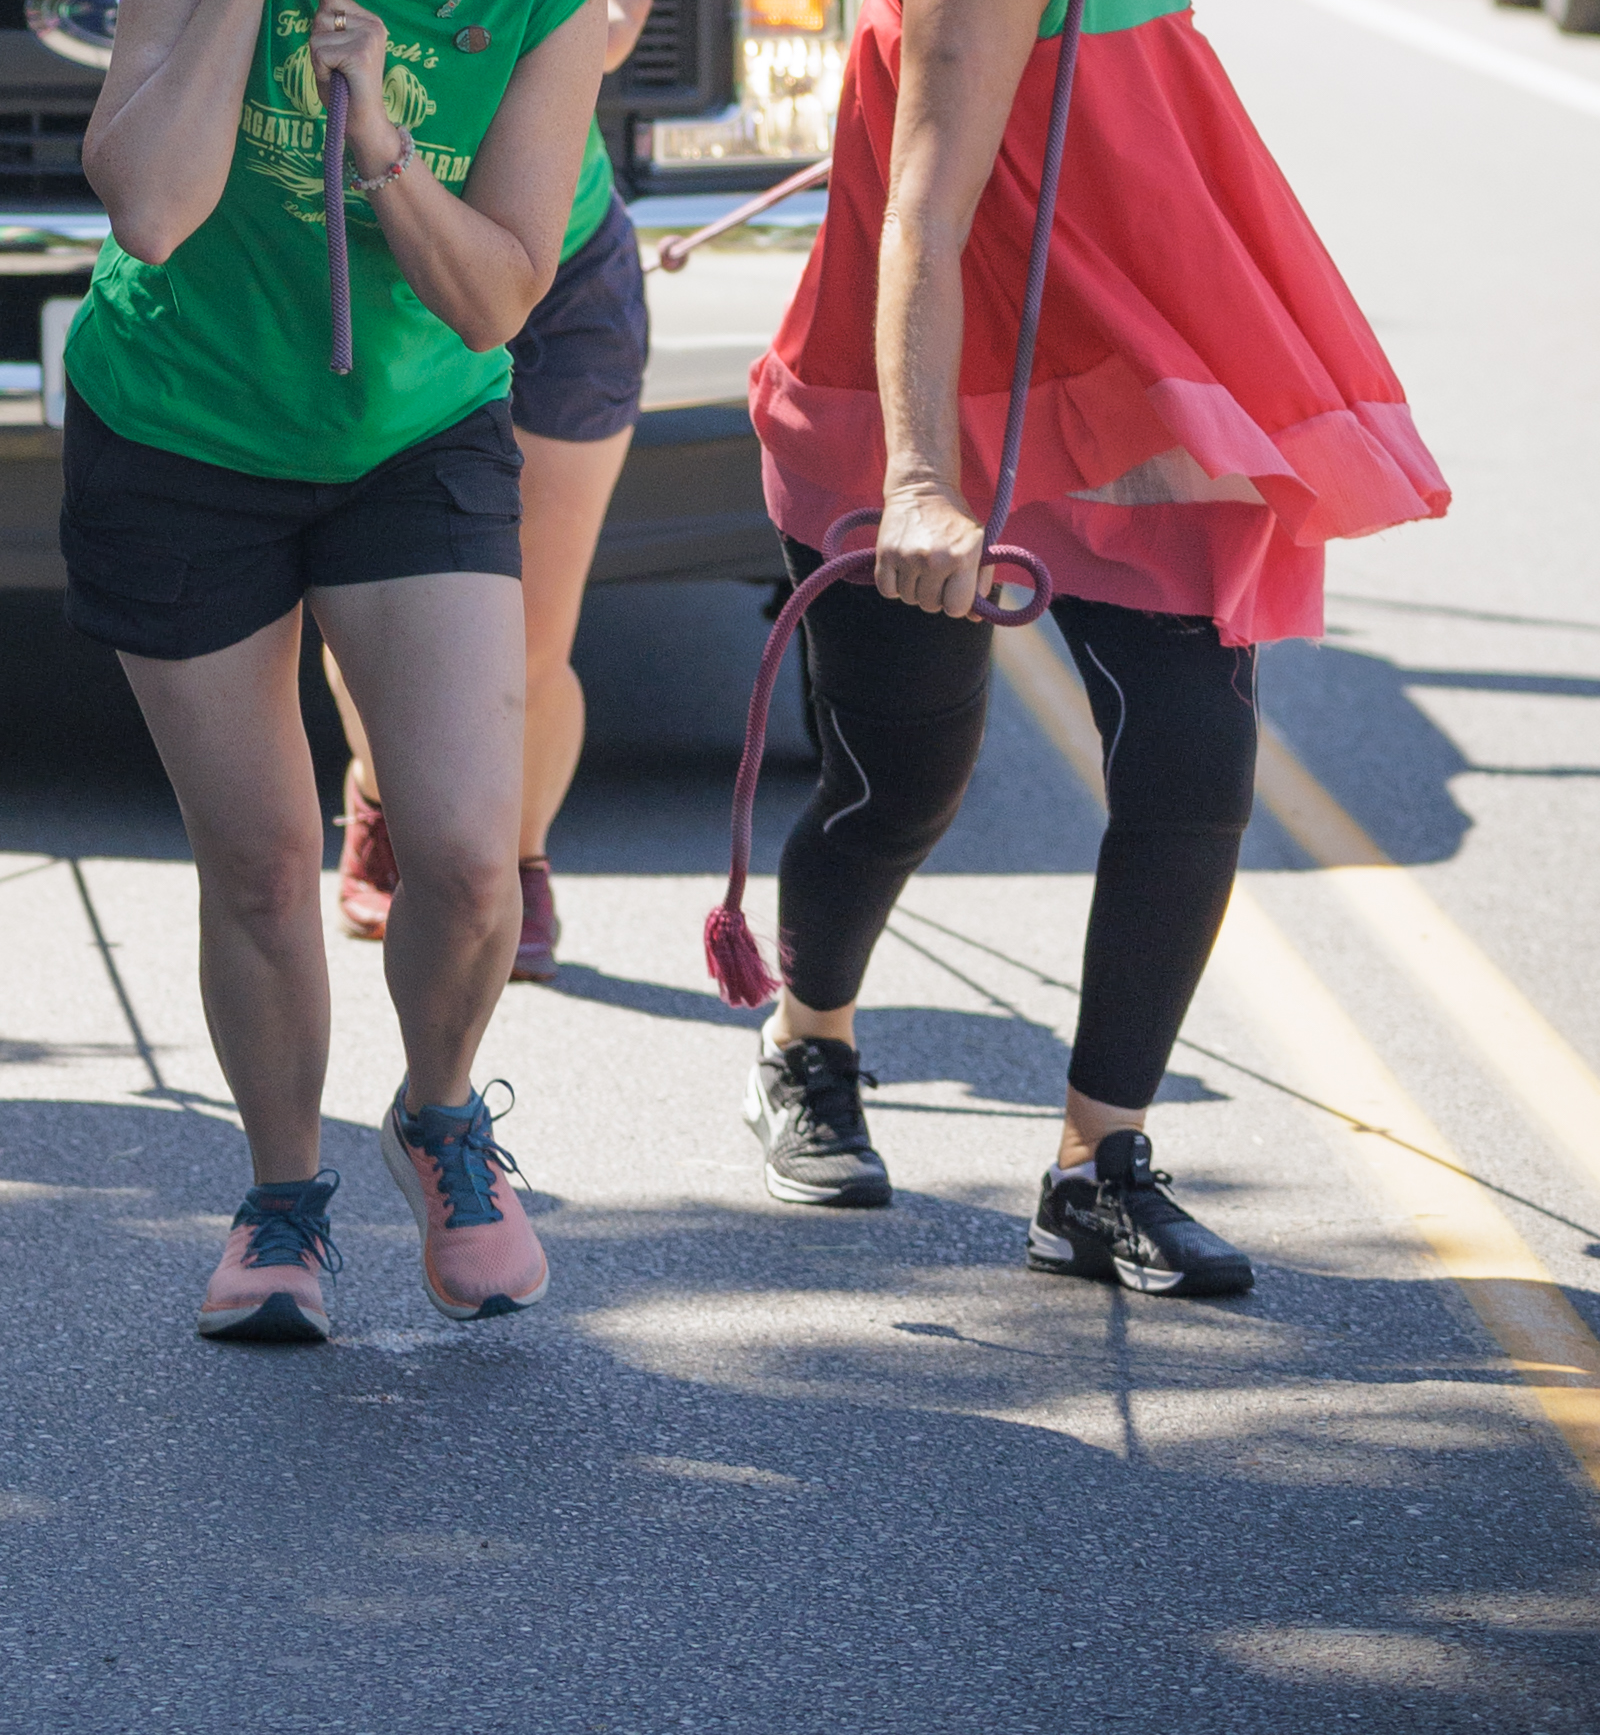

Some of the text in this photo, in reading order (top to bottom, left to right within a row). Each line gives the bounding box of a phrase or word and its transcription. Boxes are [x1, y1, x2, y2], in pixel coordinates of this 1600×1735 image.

[384, 29, 440, 70] osh's
[241, 103, 314, 149] RGANIC
[415, 148, 471, 182] ARM
